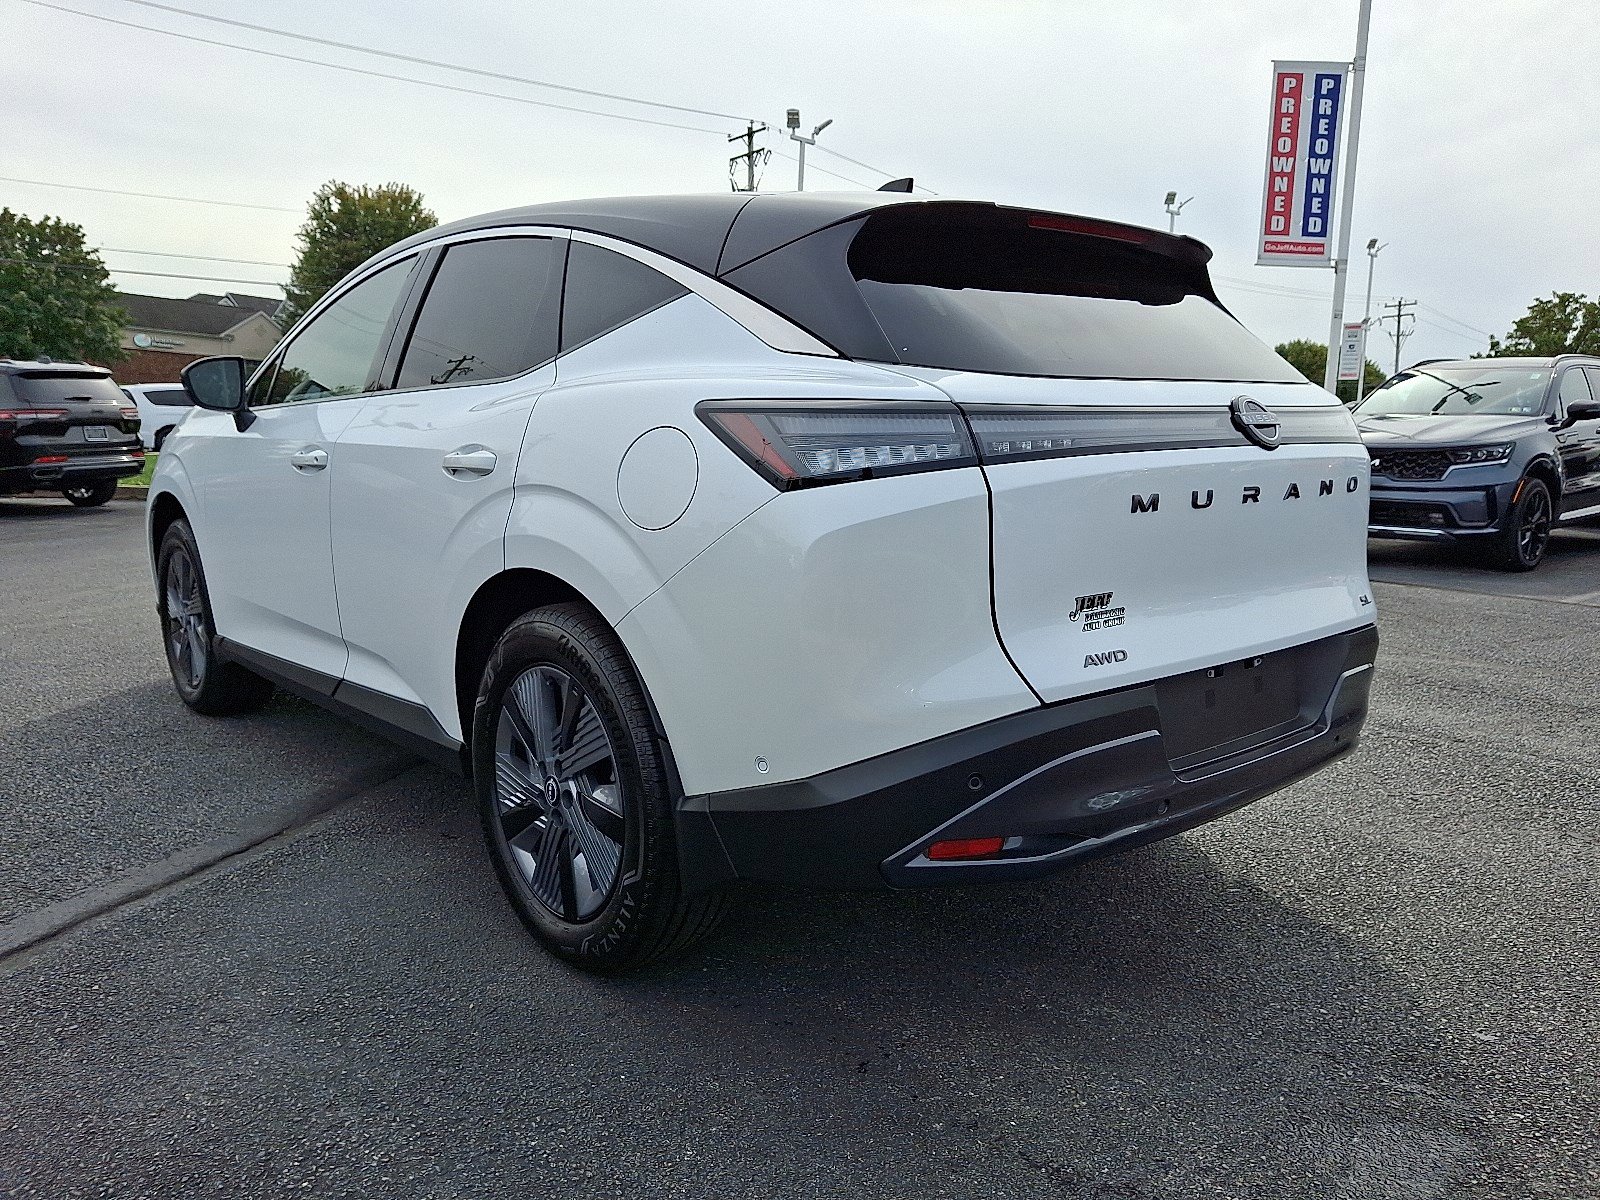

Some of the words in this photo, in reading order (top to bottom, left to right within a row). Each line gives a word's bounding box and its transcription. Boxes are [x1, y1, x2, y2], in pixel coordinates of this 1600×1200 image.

[1271, 77, 1297, 232] PREOWNED
[1308, 78, 1335, 233] PREOWNED
[1130, 476, 1358, 514] MURANO
[1069, 591, 1114, 622] JEFF
[1083, 649, 1128, 668] AWD
